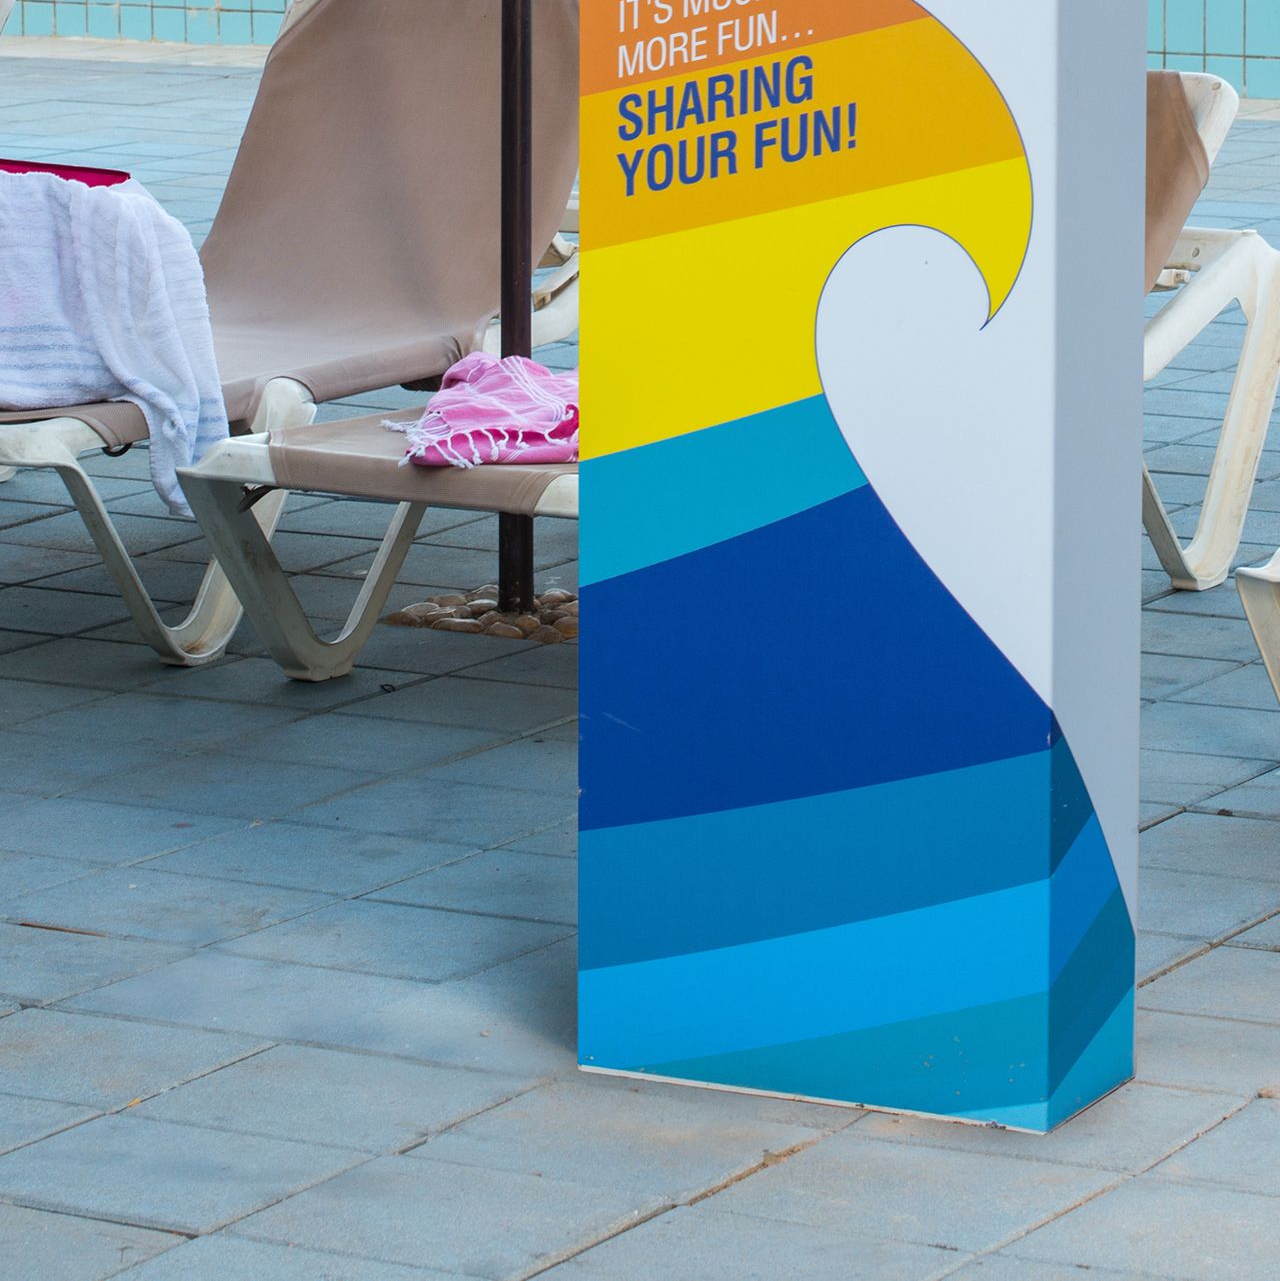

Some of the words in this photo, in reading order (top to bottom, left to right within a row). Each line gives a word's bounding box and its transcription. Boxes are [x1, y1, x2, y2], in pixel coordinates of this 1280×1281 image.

[617, 25, 708, 79] MORE
[617, 54, 814, 142] SHARING
[616, 129, 739, 197] YOUR
[753, 102, 858, 169] FUN!
